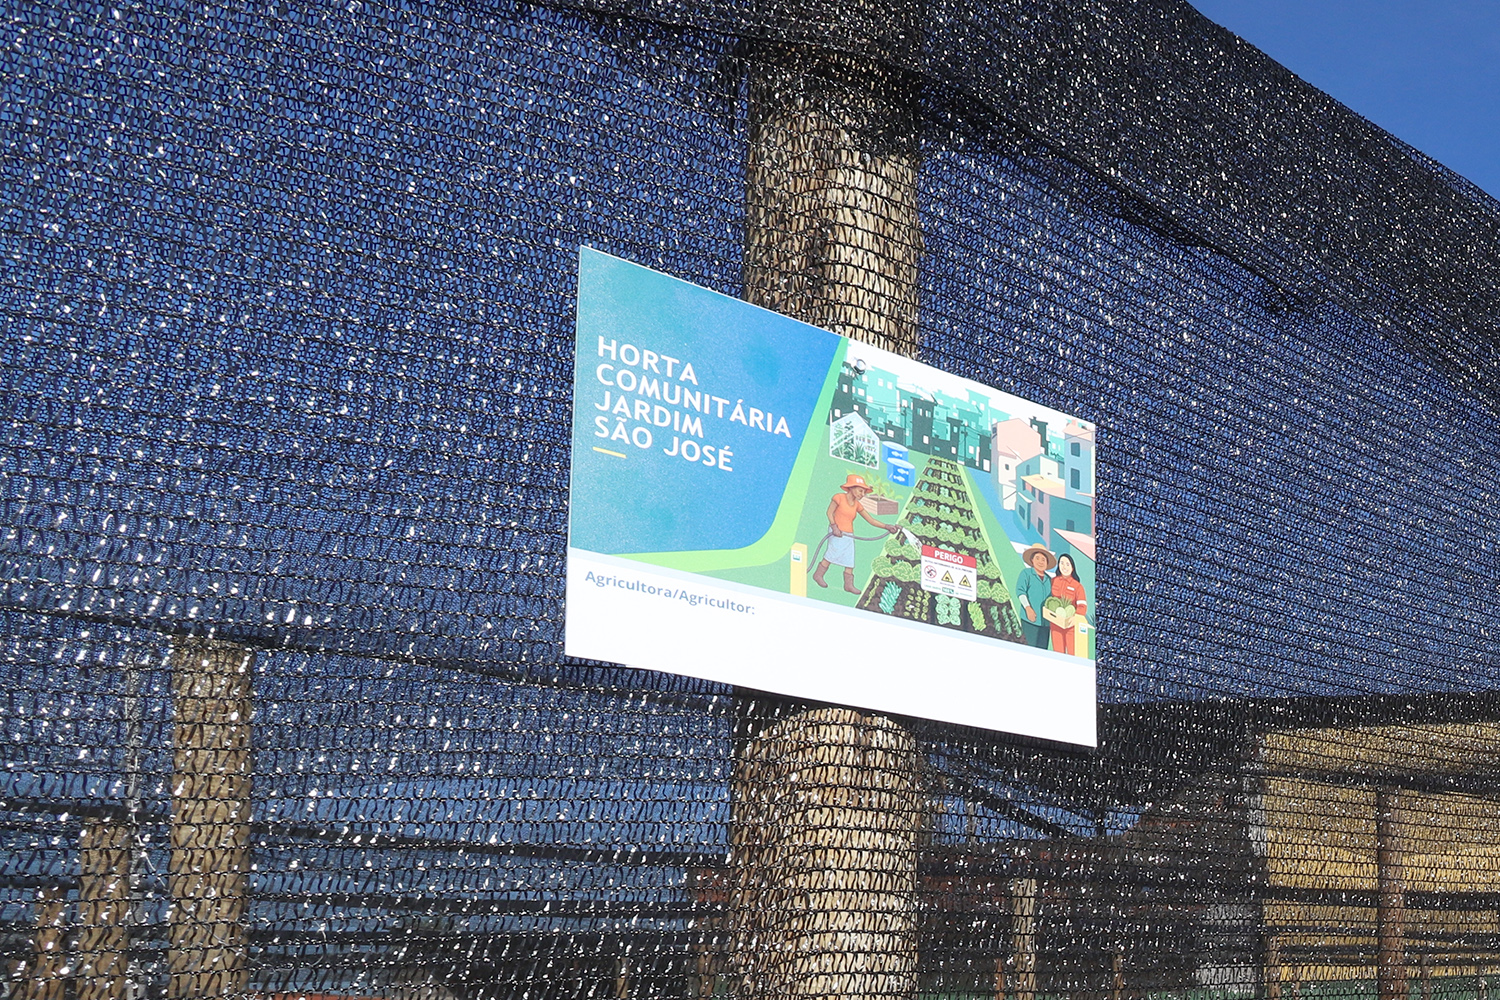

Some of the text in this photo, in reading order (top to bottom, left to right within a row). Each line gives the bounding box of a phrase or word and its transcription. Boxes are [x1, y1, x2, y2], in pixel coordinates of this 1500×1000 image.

[598, 335, 699, 386] HORTA
[594, 390, 704, 439] JARDIM
[596, 363, 792, 439] COMUNITÁRIA
[594, 415, 734, 472] SÃO JOSÉ
[934, 550, 964, 564] PERIGO
[585, 570, 756, 615] Agricultora/Agricultor:
